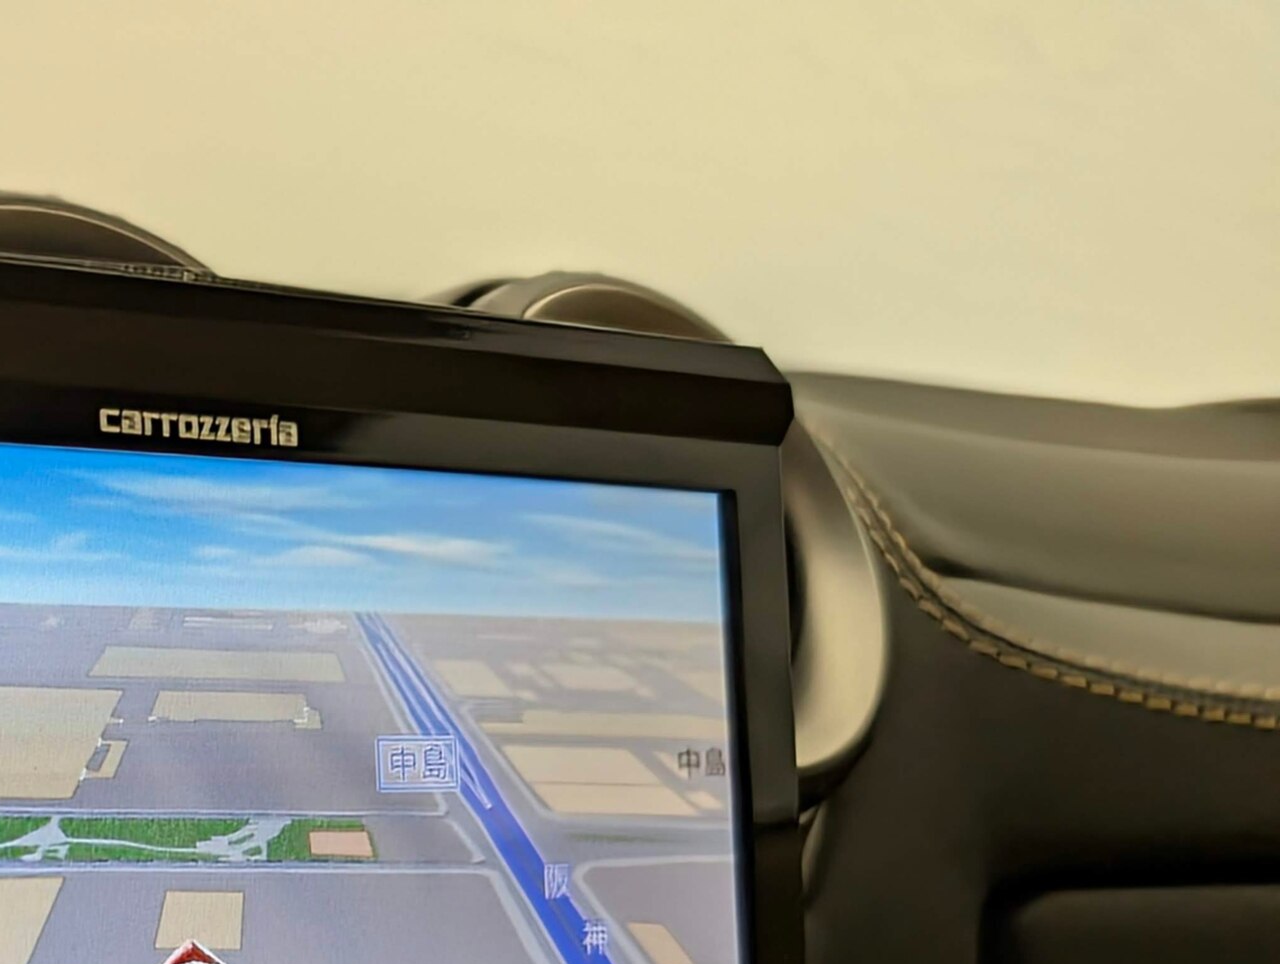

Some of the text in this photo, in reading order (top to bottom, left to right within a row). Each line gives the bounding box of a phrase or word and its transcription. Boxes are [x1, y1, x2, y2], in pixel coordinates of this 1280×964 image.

[99, 408, 298, 446] carrozzeria
[389, 744, 449, 781] 中島
[677, 747, 726, 778] 中島
